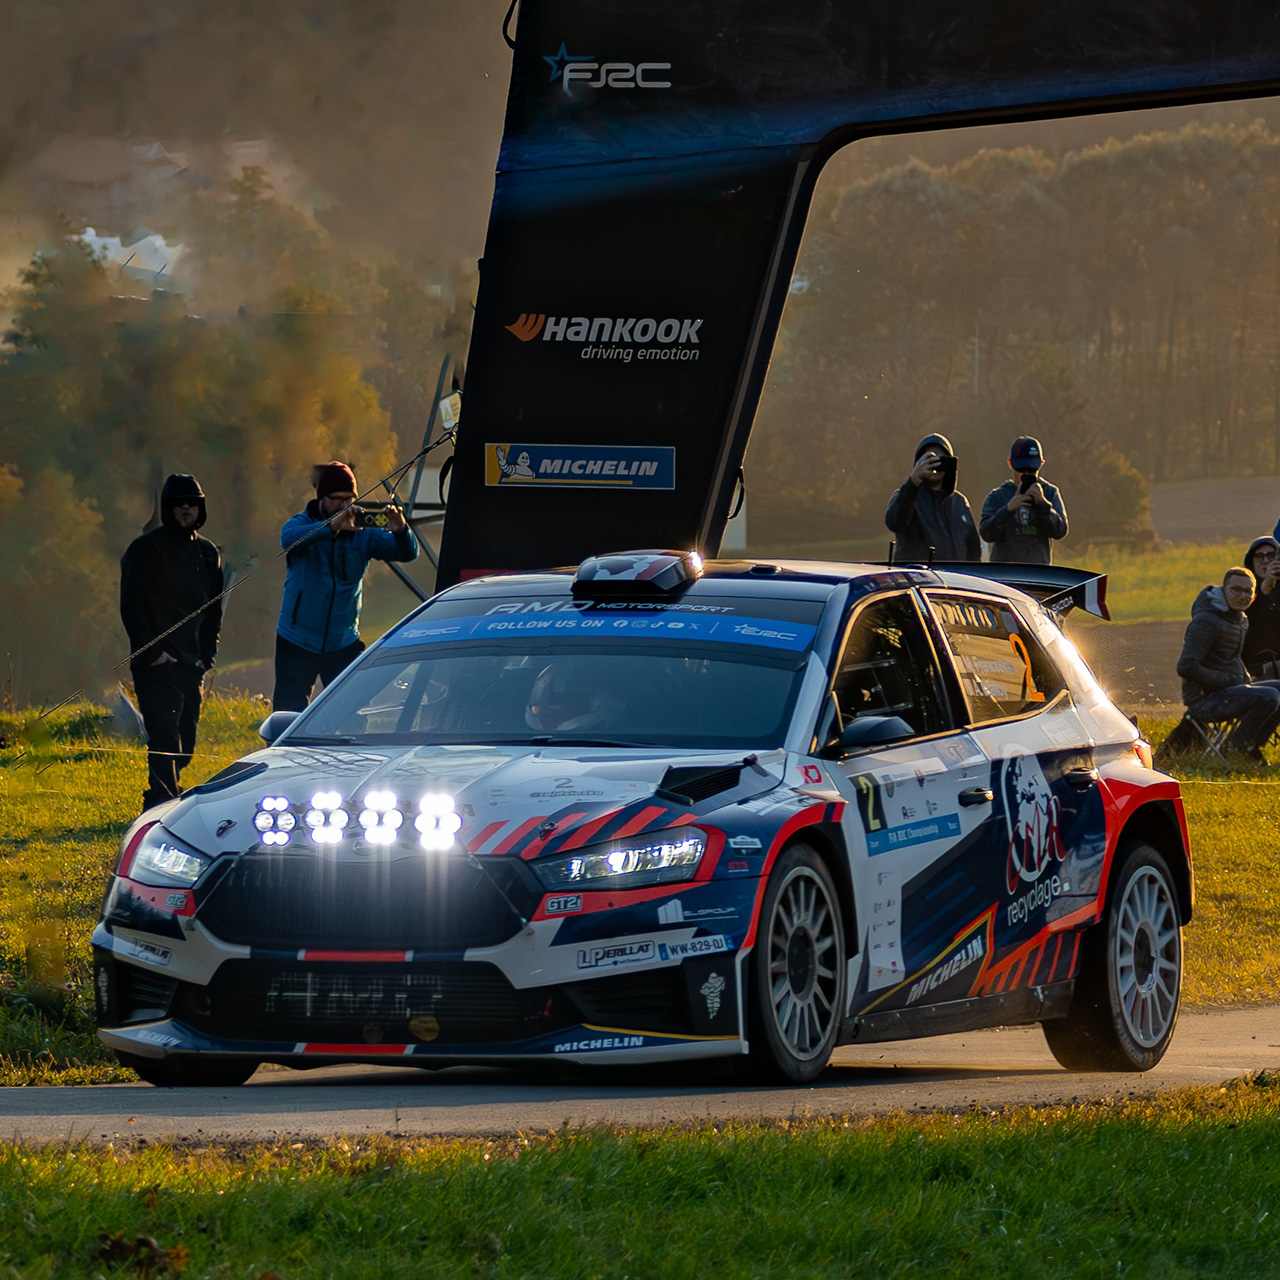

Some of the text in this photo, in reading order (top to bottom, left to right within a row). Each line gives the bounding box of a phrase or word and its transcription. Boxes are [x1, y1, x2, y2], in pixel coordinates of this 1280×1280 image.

[580, 345, 700, 363] driving emotion
[538, 457, 659, 476] MICHELIN
[596, 602, 736, 613] MOTORSPORT
[487, 619, 604, 630] FOLLOW US ON
[1008, 632, 1046, 703] 2
[553, 777, 575, 789] 2
[858, 776, 882, 831] 2
[904, 934, 985, 1007] MICHELIN
[554, 1036, 644, 1052] MICHELIN
